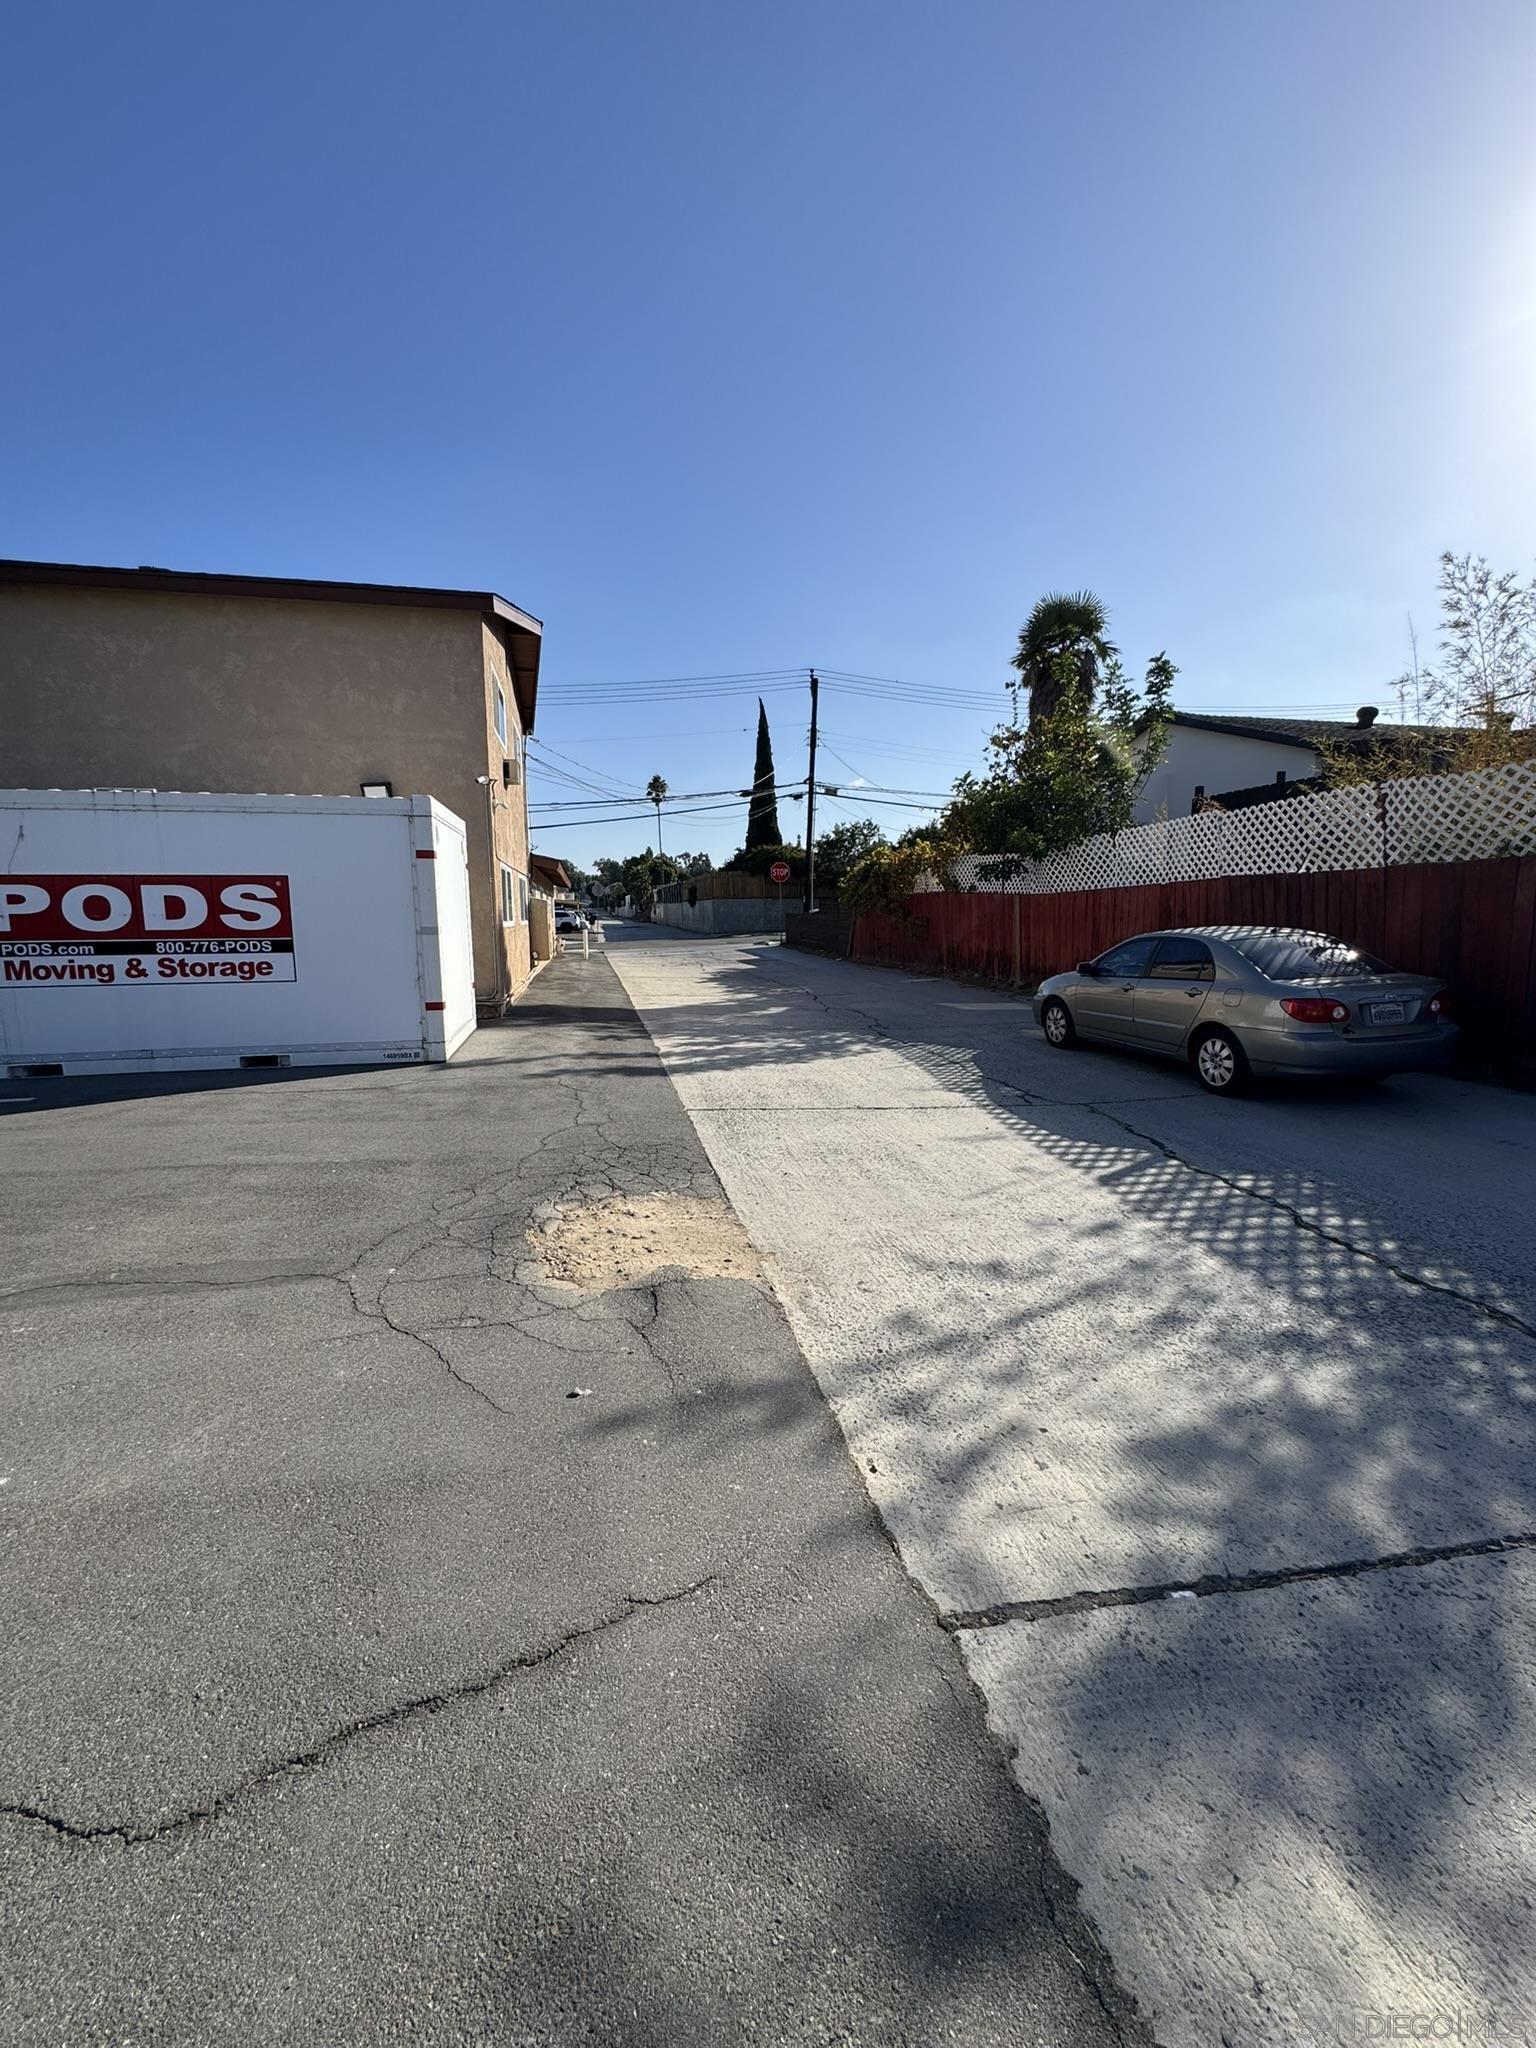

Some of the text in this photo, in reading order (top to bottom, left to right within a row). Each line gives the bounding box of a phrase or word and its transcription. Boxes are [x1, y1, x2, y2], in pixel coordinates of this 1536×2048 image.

[772, 868, 789, 877] STOP
[0, 884, 282, 932] PODS
[1, 943, 95, 956] PODS.com
[156, 941, 273, 954] 800-776-PODS
[4, 957, 274, 983] Moving & Storage
